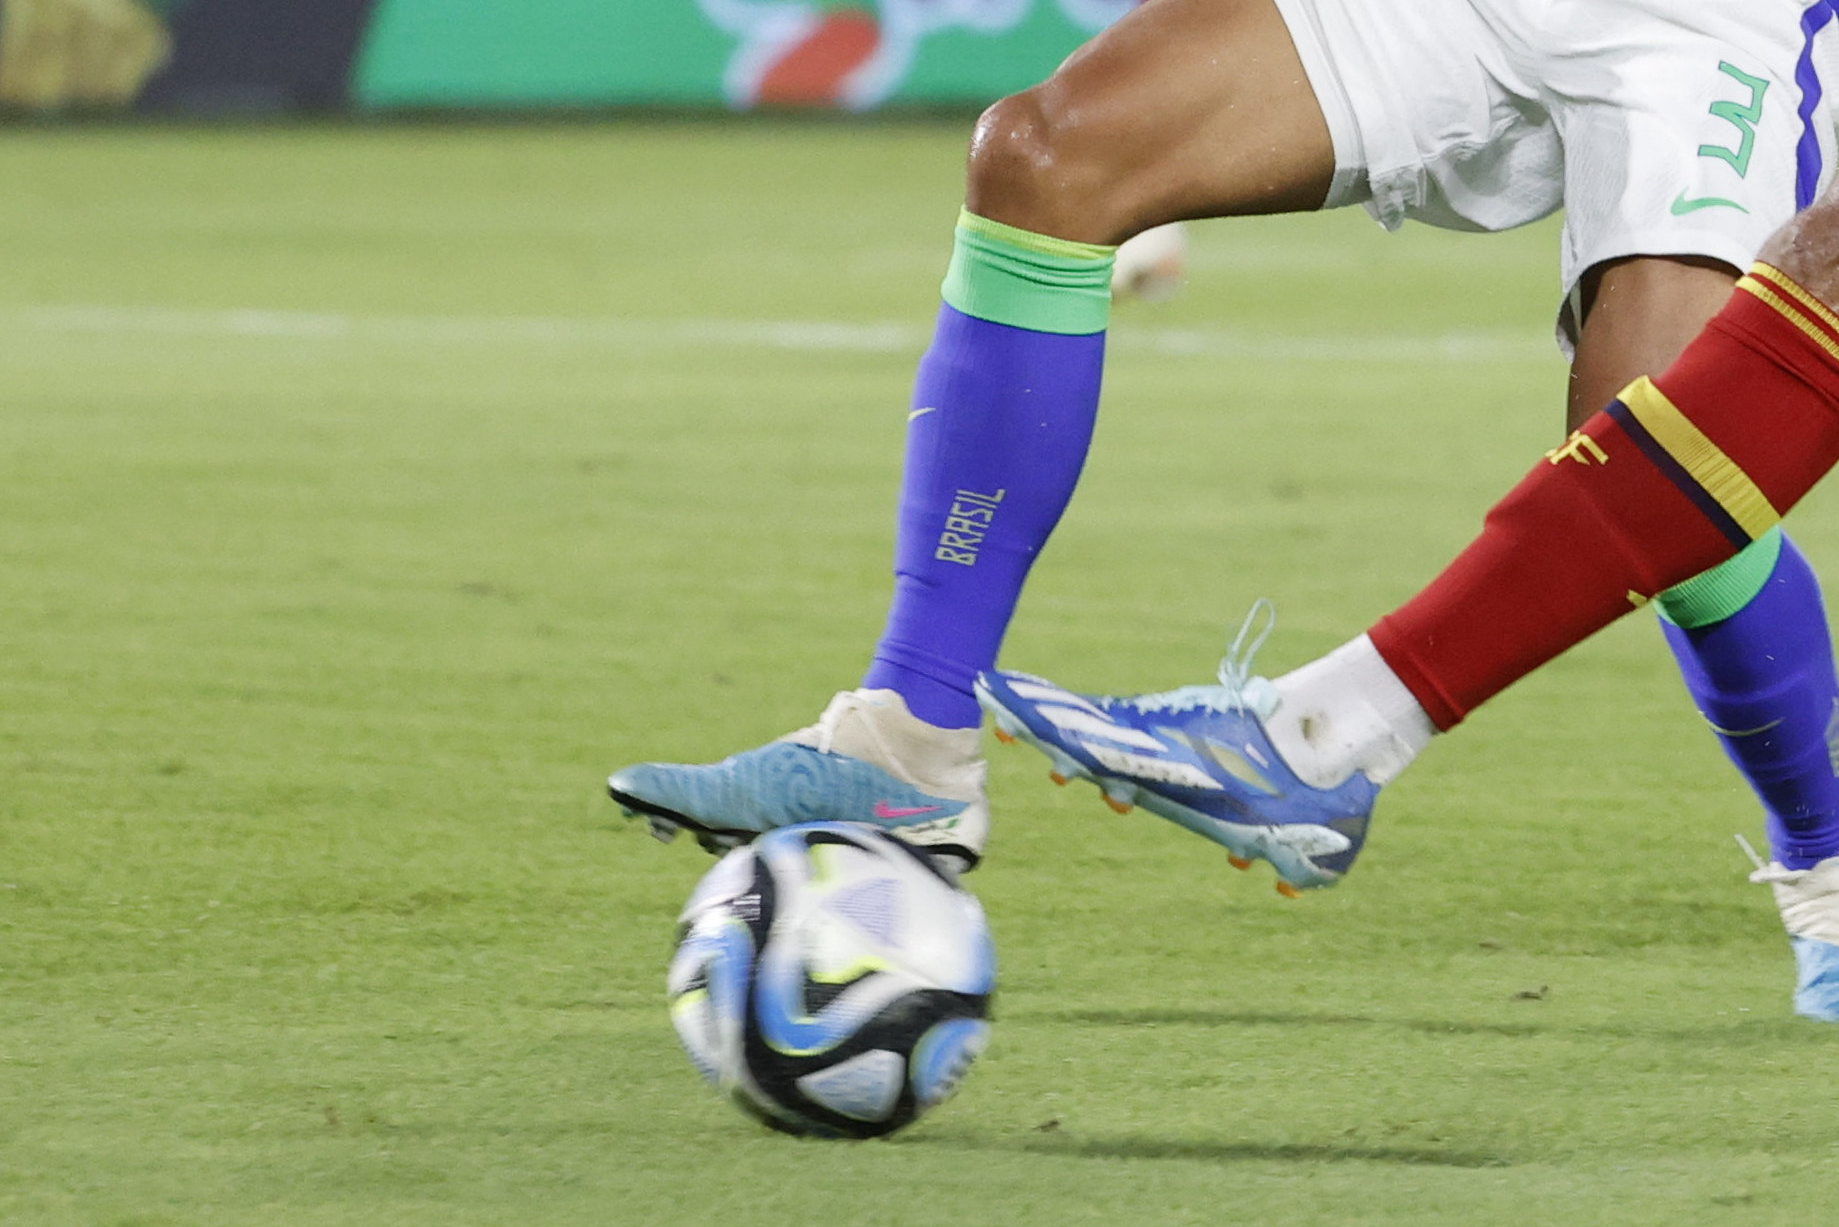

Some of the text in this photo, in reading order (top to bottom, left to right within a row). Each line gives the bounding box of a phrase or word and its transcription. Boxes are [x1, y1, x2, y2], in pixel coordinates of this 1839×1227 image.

[1697, 59, 1771, 180] 3
[1545, 429, 1610, 466] F
[934, 488, 1006, 567] BRASIL
